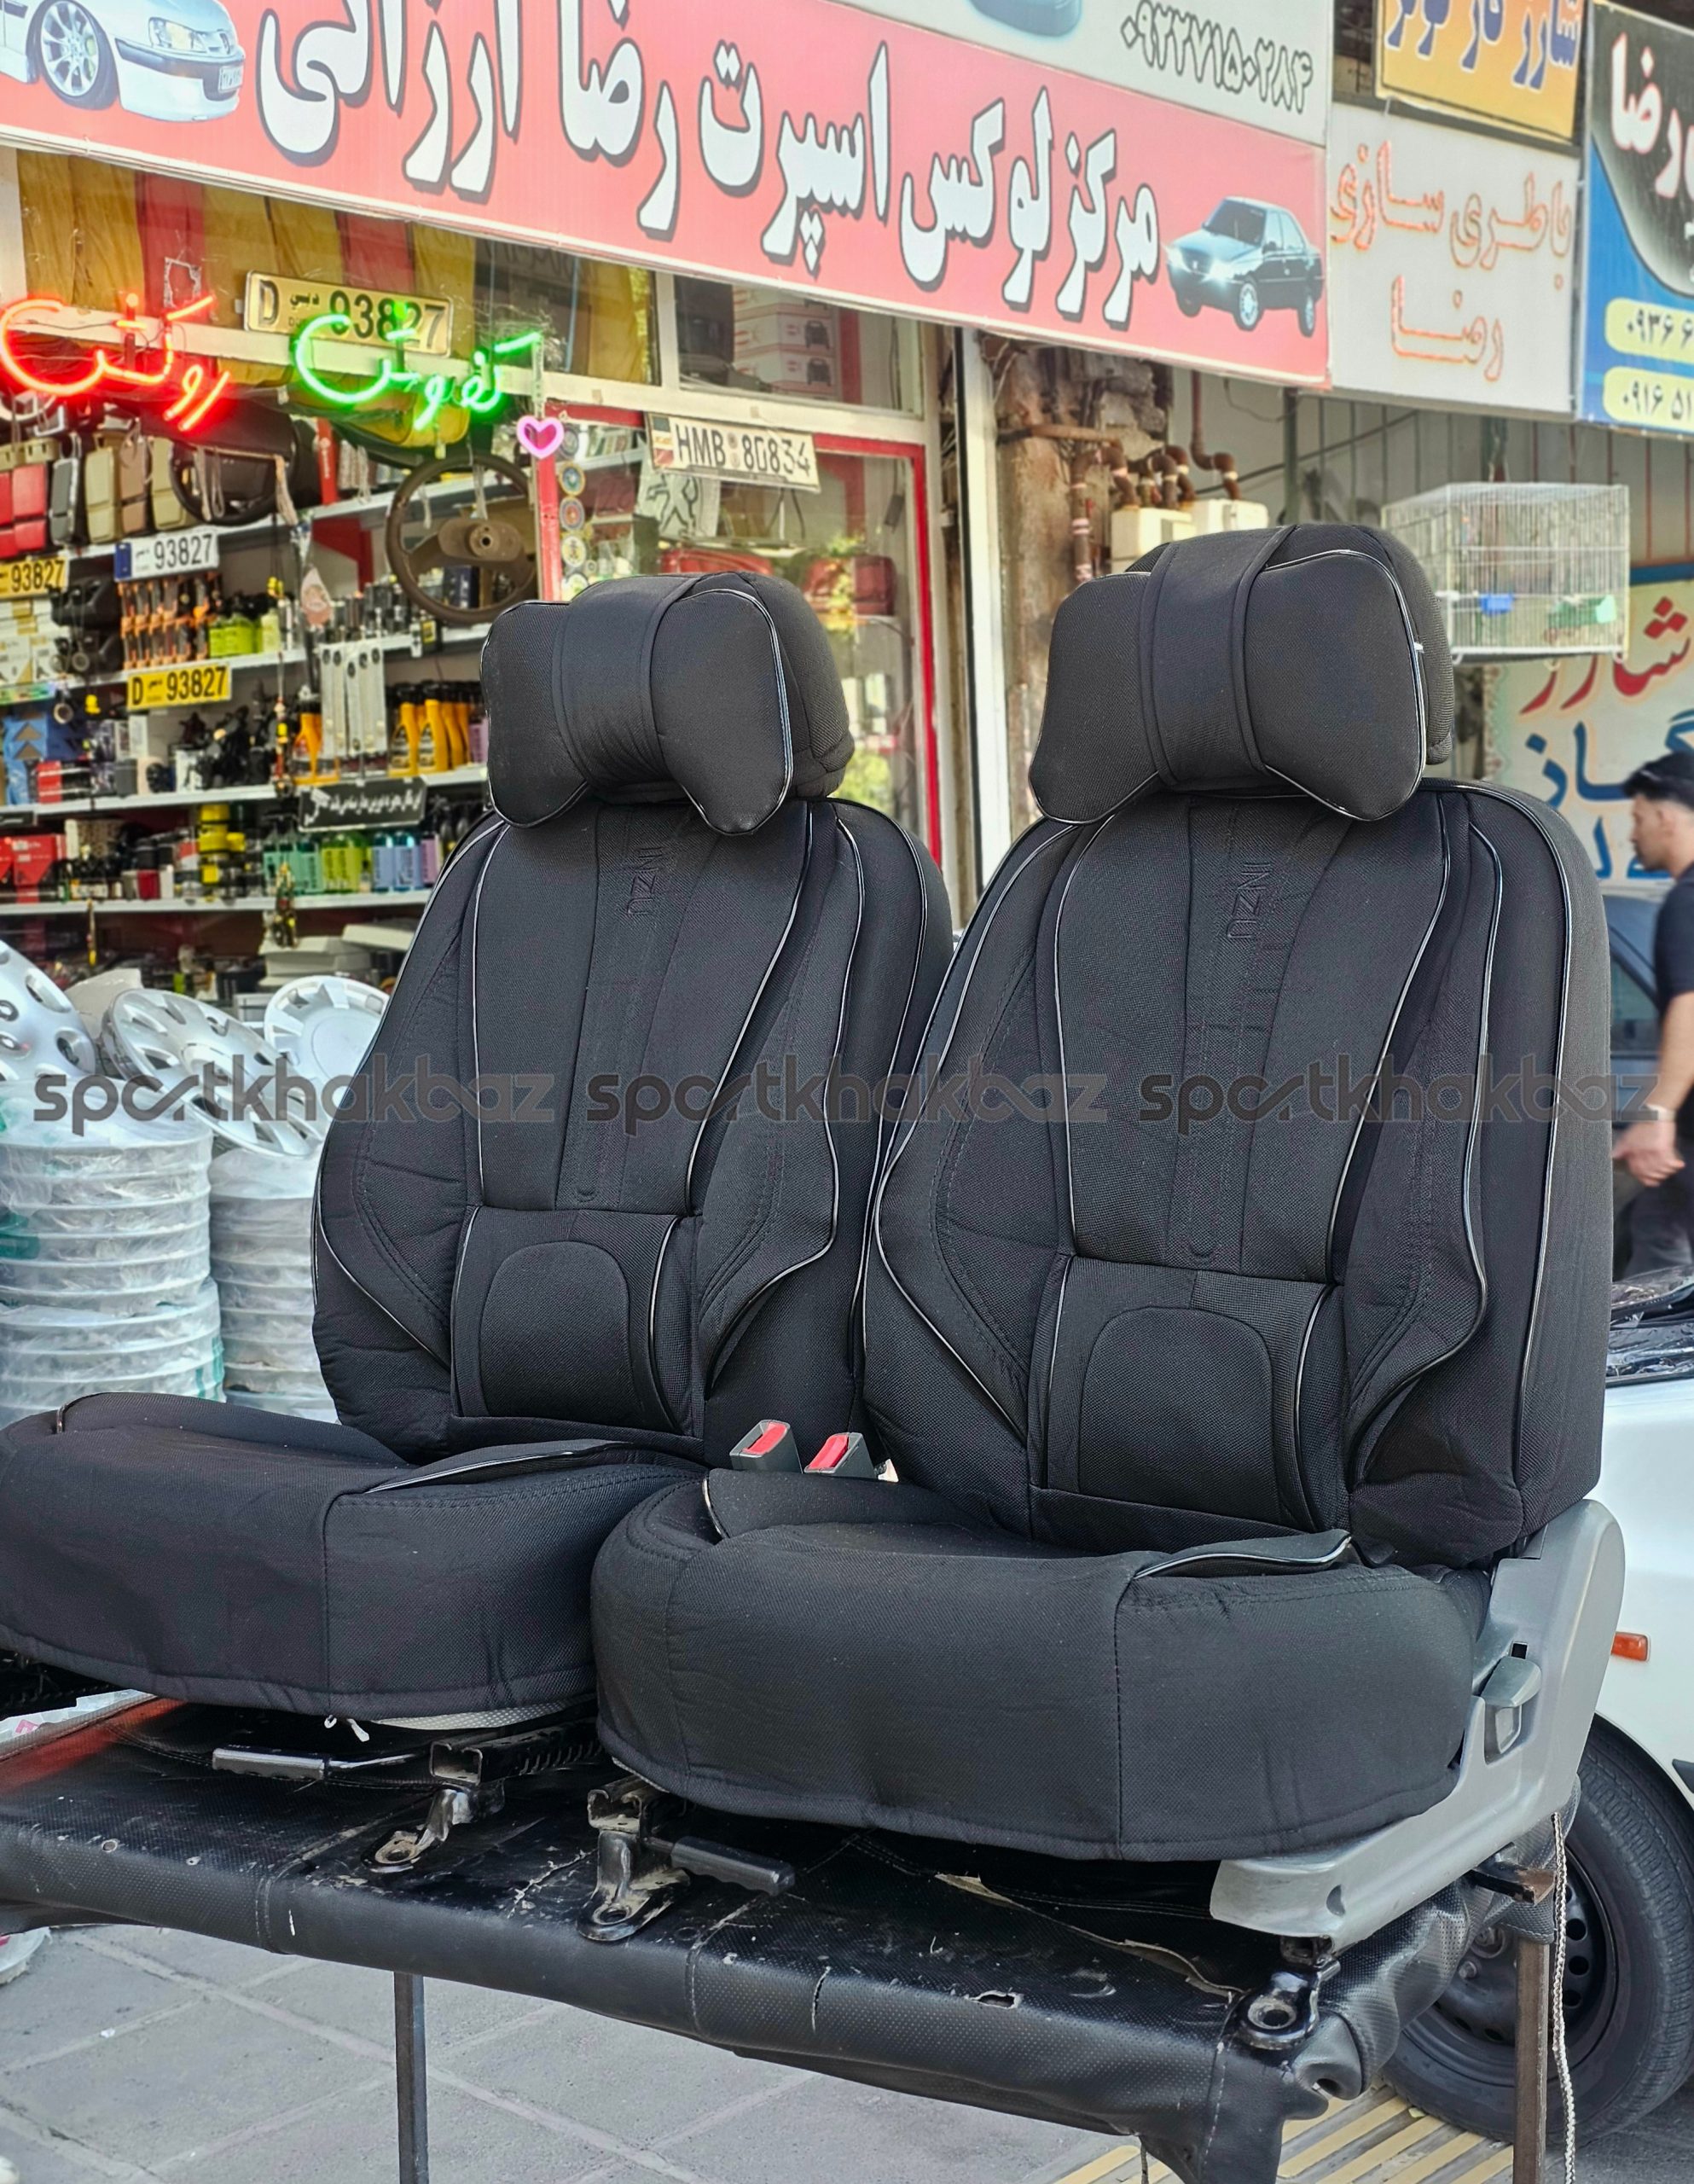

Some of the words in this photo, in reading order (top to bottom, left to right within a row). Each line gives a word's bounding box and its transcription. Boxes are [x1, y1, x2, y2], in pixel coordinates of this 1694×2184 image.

[559, 0, 680, 241] رضا
[699, 39, 891, 277] اسپرت
[900, 84, 1055, 311] لوکس
[1058, 128, 1160, 331] مرکز
[1330, 140, 1445, 252] سازی
[1450, 171, 1573, 291] باطری
[258, 278, 280, 328] D
[1390, 274, 1505, 382] رضا
[676, 423, 727, 468] HMB
[10, 559, 66, 593] 93827
[154, 532, 214, 570] 93827
[131, 677, 144, 706] D
[165, 665, 228, 701] 93827
